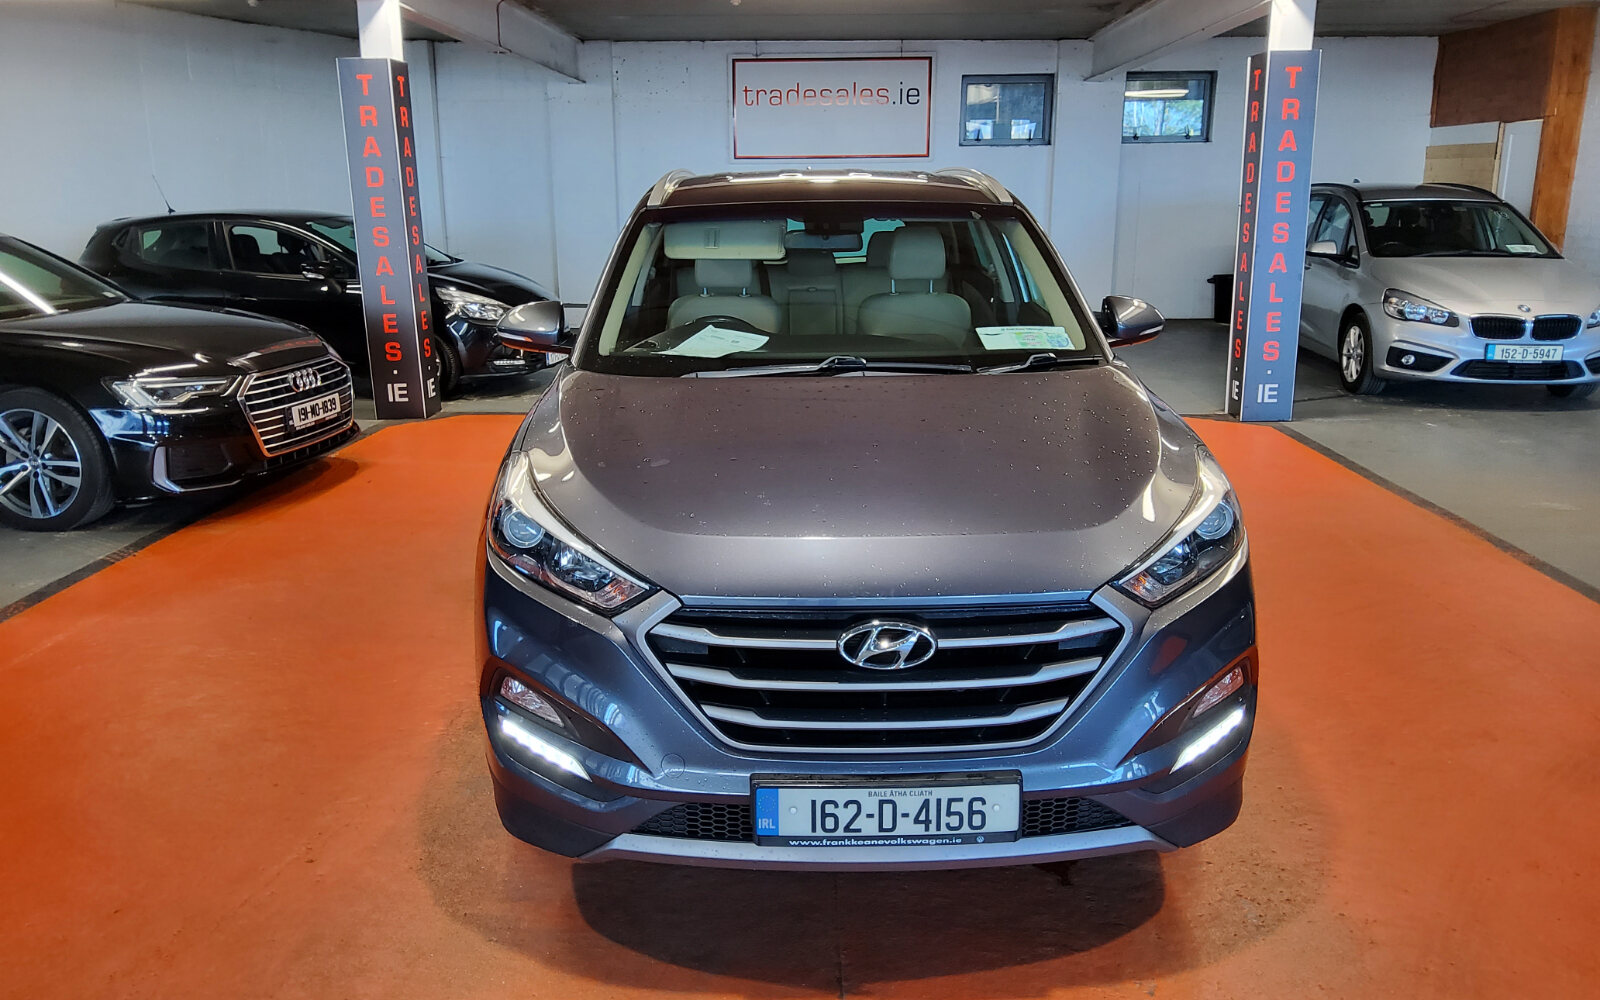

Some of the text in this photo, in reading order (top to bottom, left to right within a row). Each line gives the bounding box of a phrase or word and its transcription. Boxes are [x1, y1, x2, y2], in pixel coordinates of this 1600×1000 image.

[742, 81, 920, 106] tradesales.ie
[1500, 347, 1558, 360] 152-D-5947
[297, 397, 338, 422] 191-MO-1839
[867, 790, 888, 798] BAILE
[909, 789, 933, 797] CLIATH
[810, 797, 987, 834] 162-D-4156
[758, 818, 776, 830] IRL
[788, 837, 962, 847] www.frankkeanevolkswagen.ie
